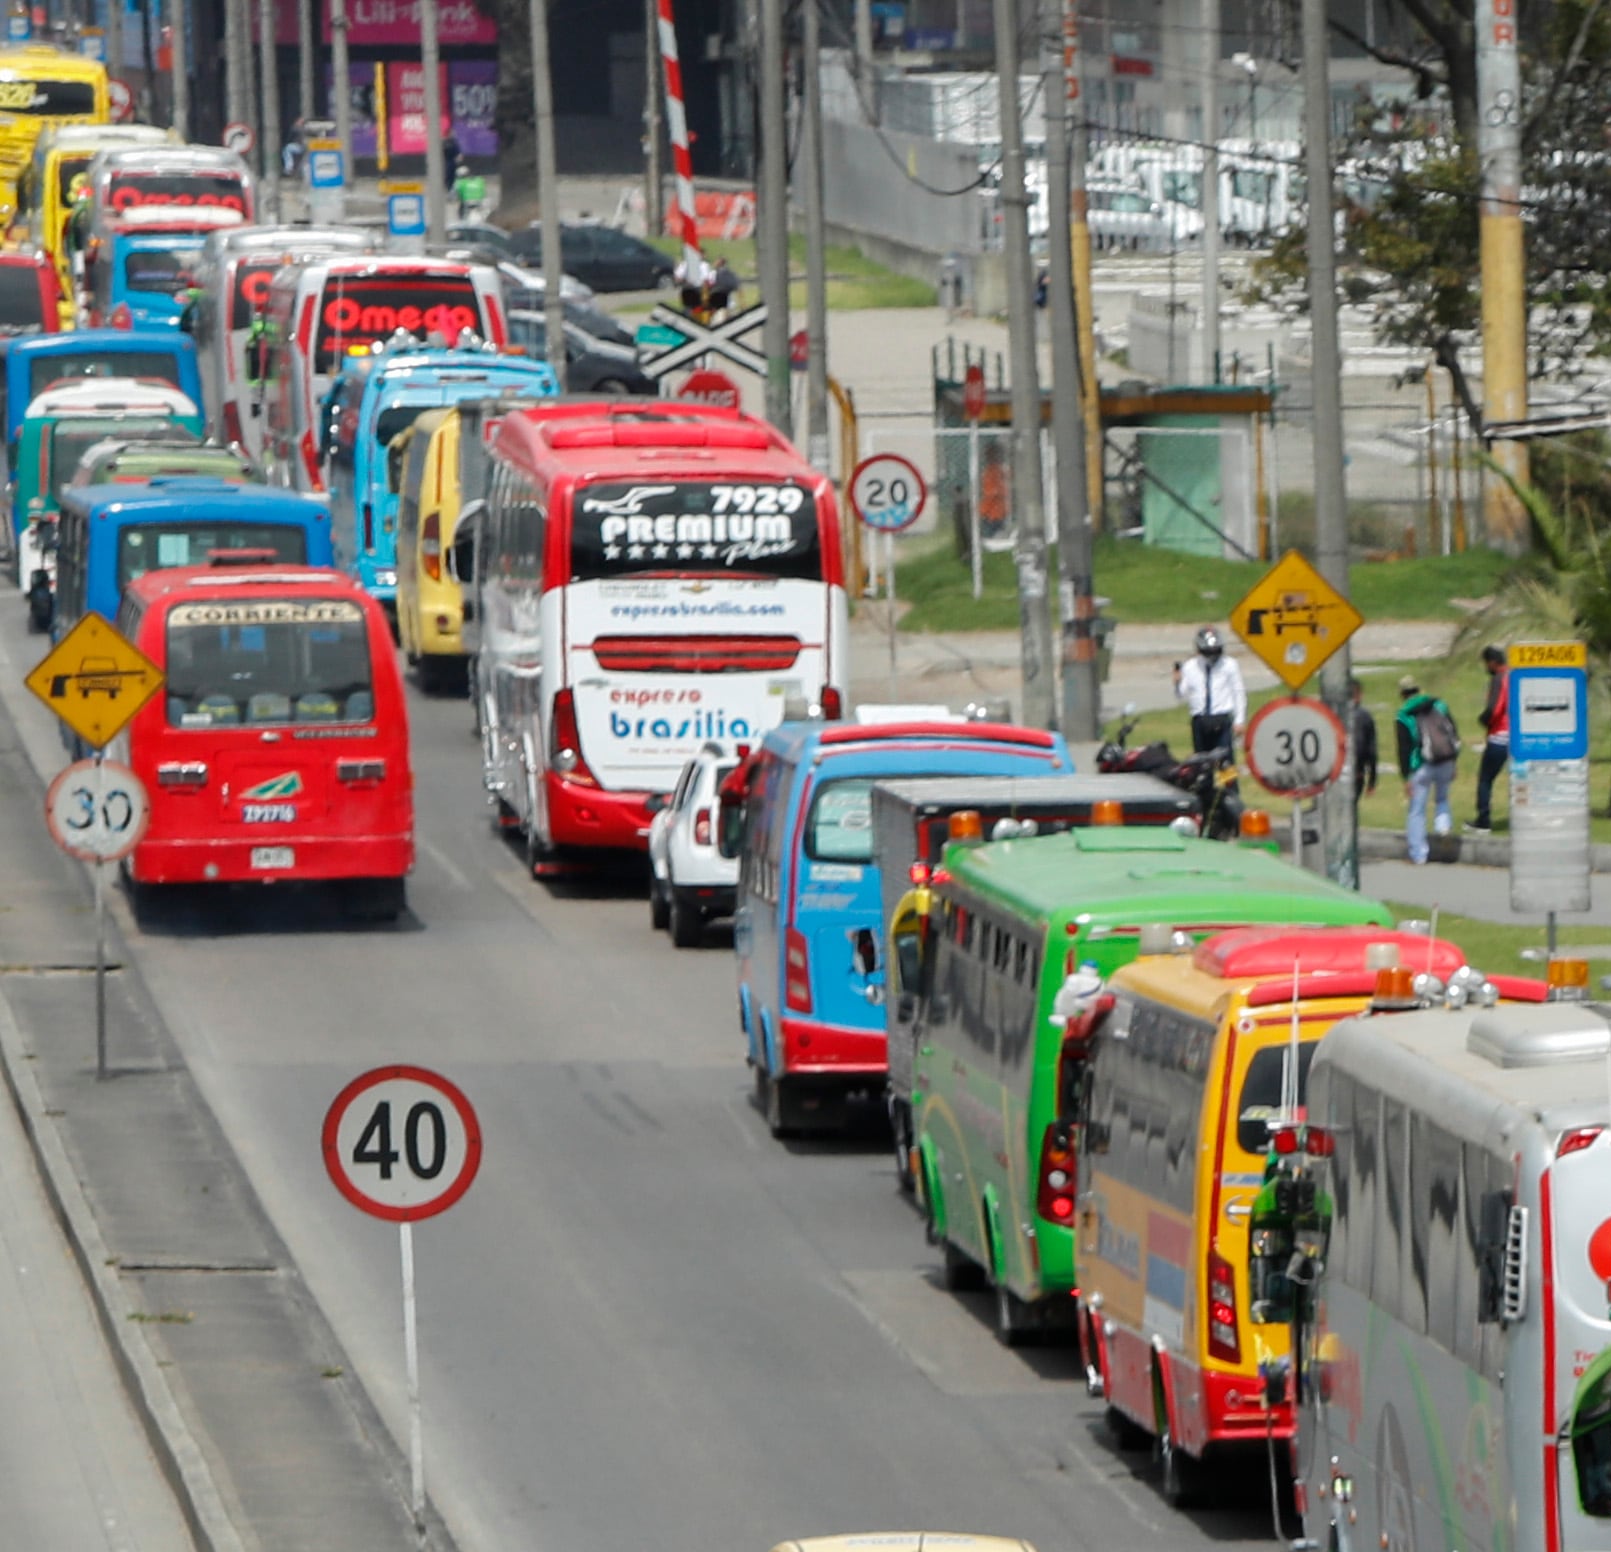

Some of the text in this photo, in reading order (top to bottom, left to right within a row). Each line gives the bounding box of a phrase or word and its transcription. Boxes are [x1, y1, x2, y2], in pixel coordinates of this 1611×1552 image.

[710, 485, 803, 513] 7929
[866, 479, 908, 507] 20
[600, 514, 793, 543] PREMIUM
[186, 605, 345, 622] CORRIENTE
[1518, 645, 1577, 663] 129A06
[610, 709, 750, 738] brasilia
[1274, 728, 1320, 765] 30
[66, 786, 132, 832] 30
[352, 1100, 447, 1181] 40
